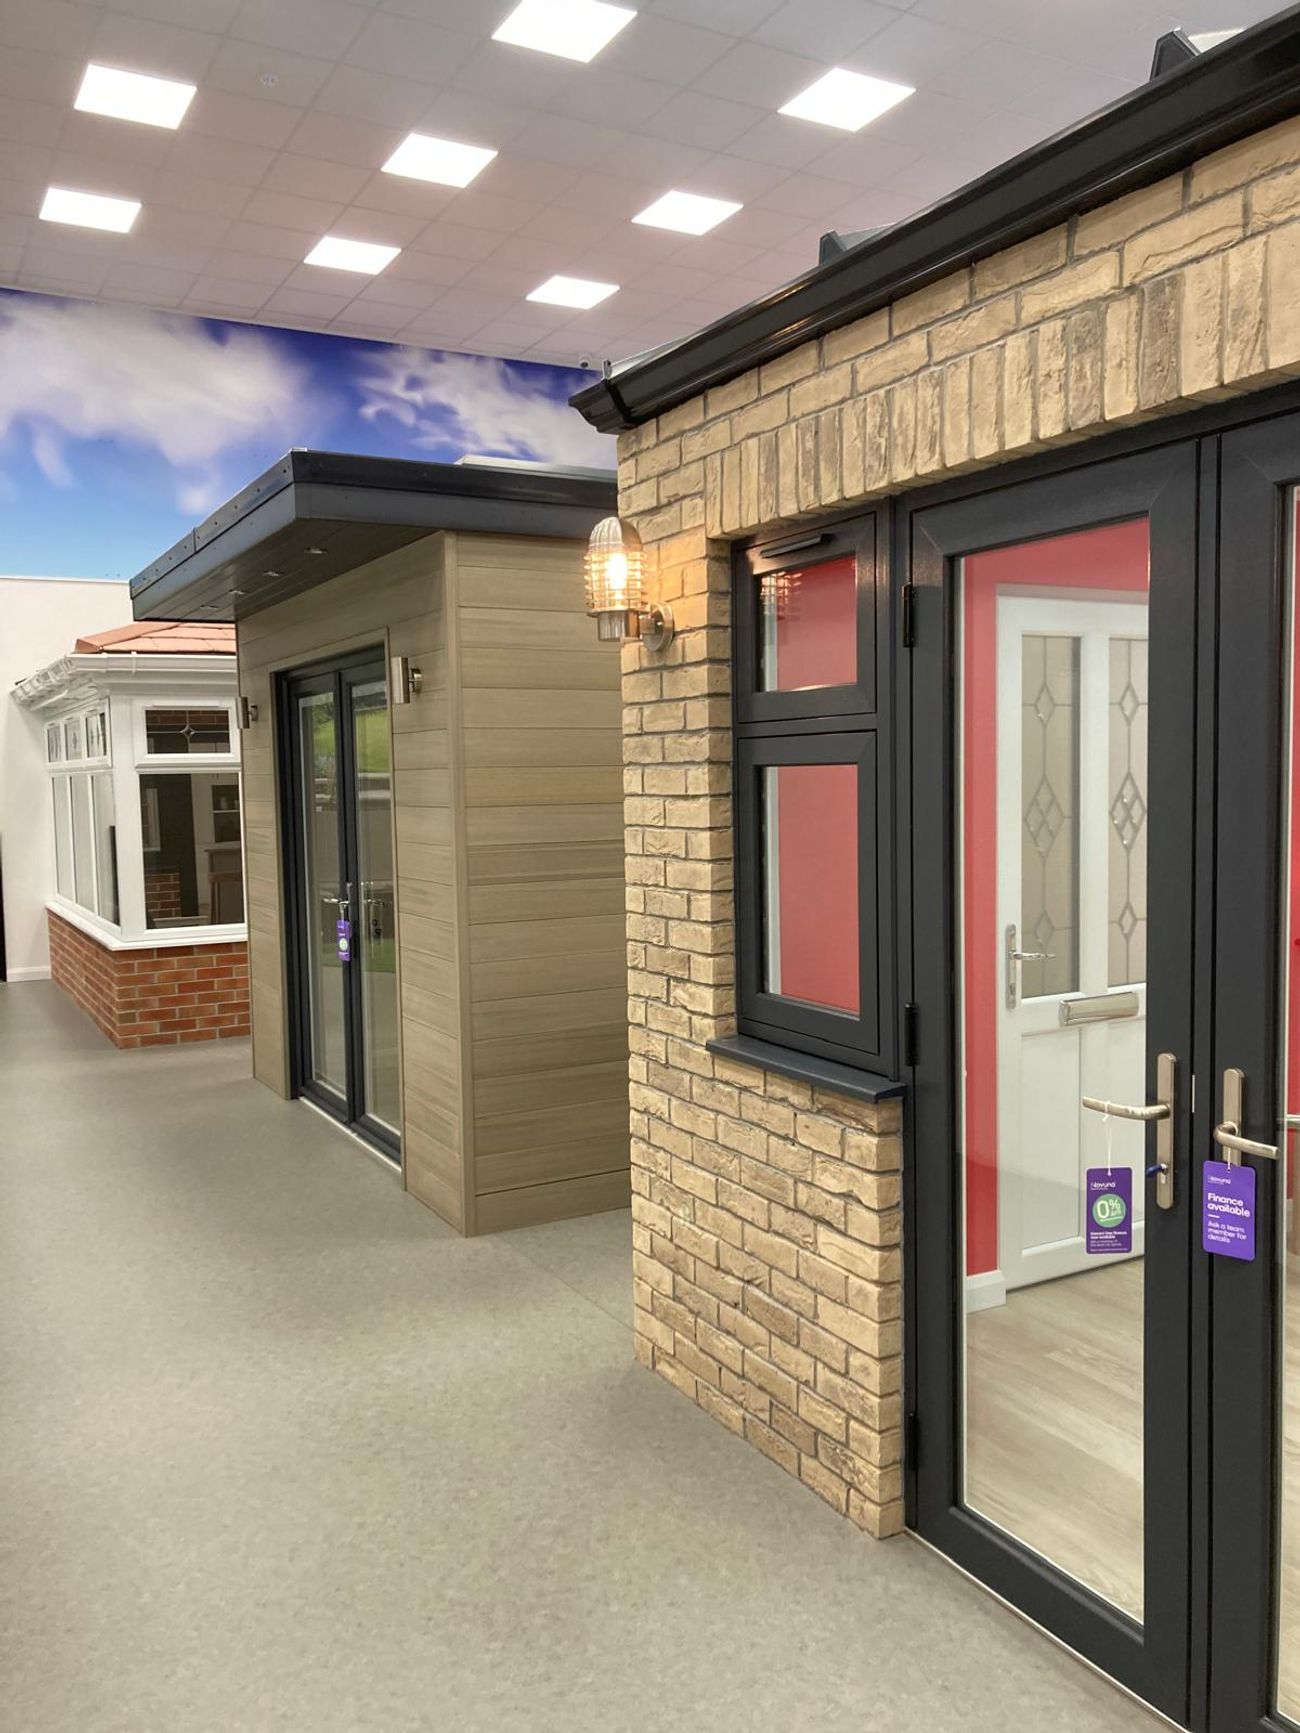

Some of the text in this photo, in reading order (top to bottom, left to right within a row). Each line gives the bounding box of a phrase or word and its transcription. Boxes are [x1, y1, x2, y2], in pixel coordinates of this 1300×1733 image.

[1207, 1192, 1244, 1207] Finance
[1097, 1198, 1121, 1219] 0%
[1207, 1203, 1251, 1218] available
[1208, 1220, 1220, 1228] Ask
[1226, 1223, 1245, 1233] team
[1207, 1234, 1231, 1243] details
[1208, 1228, 1248, 1240] member for
